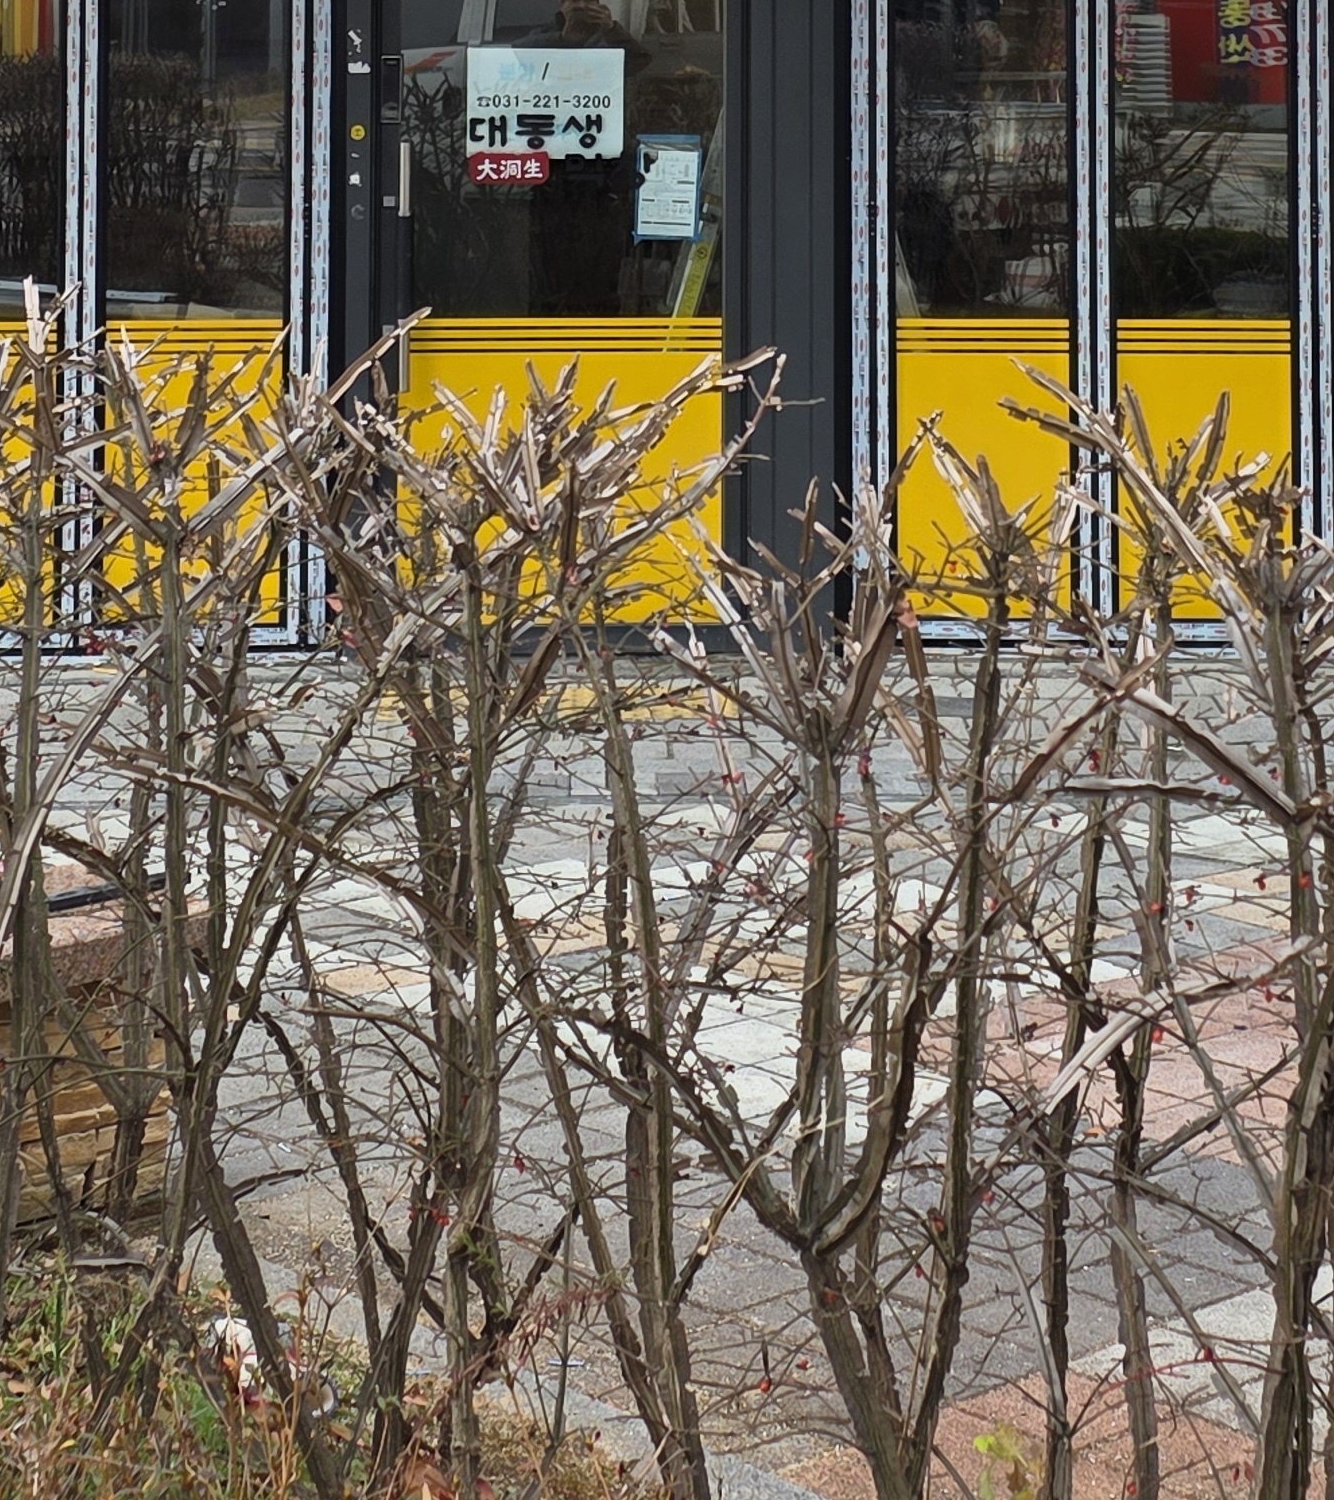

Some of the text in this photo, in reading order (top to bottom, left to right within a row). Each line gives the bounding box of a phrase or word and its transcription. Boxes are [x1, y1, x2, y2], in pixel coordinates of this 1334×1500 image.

[492, 95, 611, 108] 031-221-3200
[469, 114, 603, 149] 대동생
[476, 159, 544, 181] 大洞生
